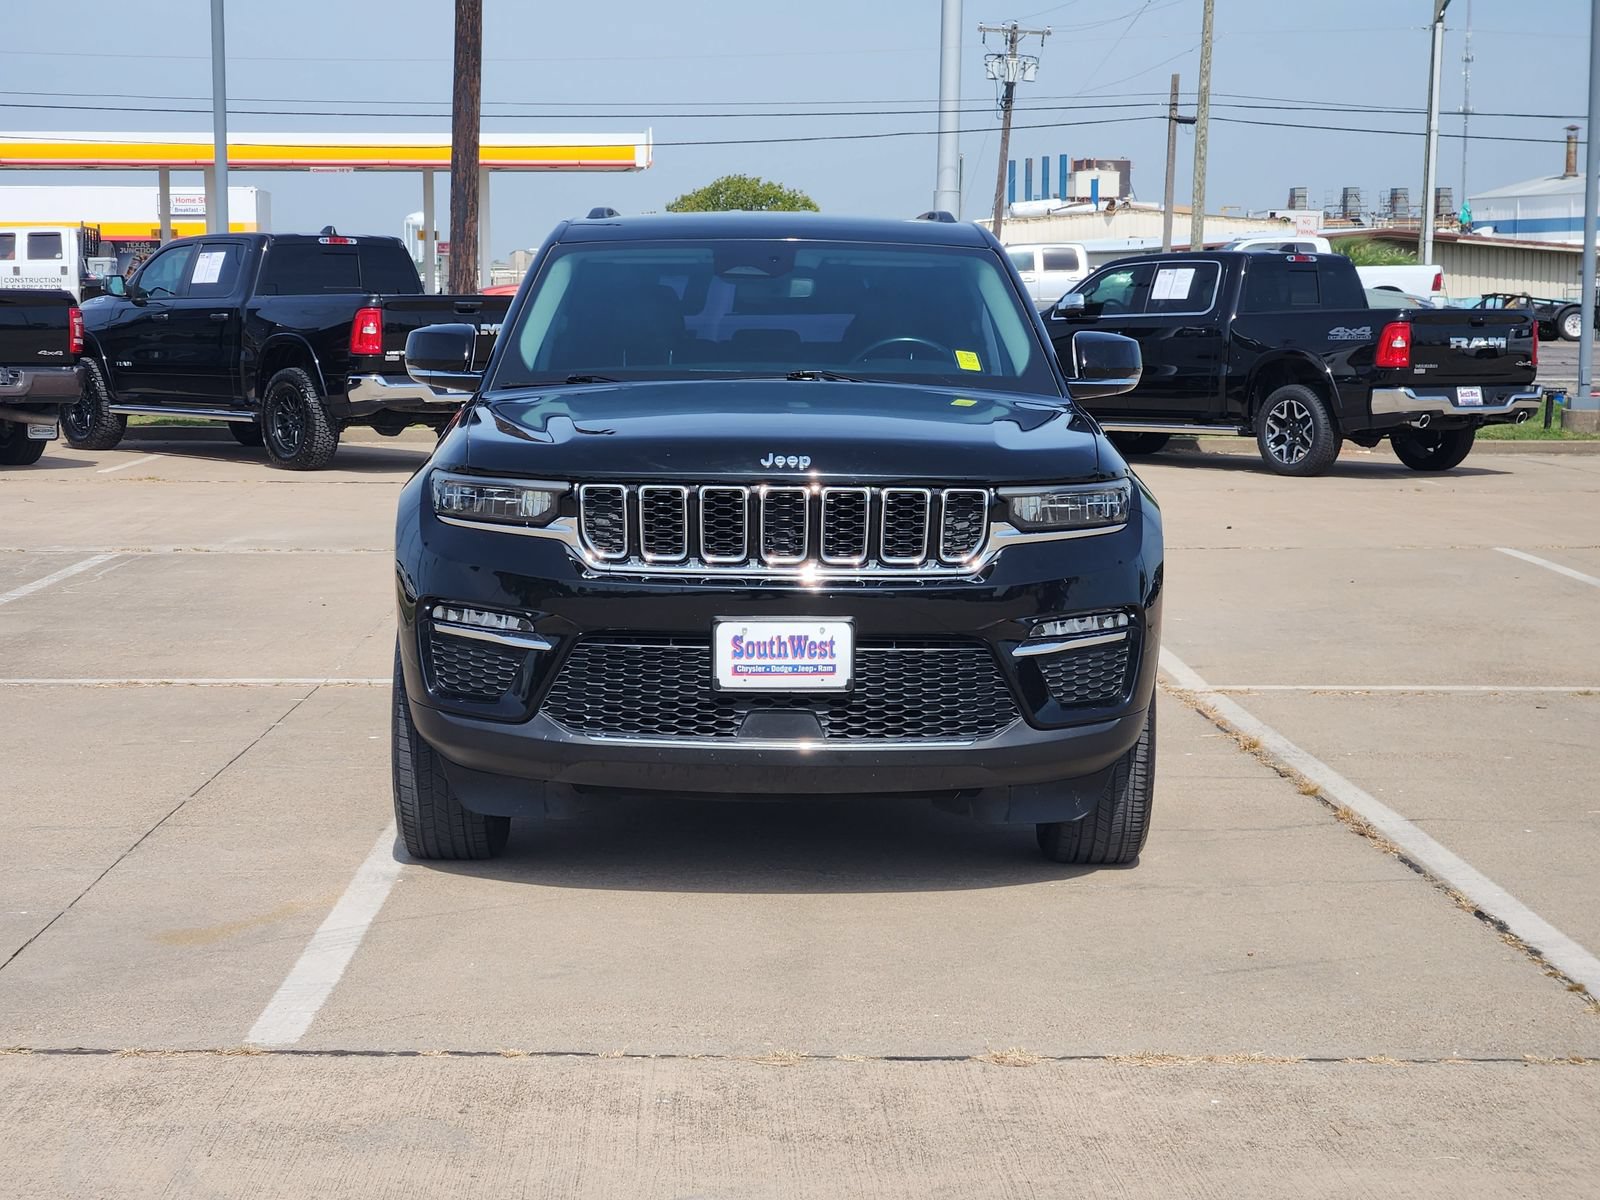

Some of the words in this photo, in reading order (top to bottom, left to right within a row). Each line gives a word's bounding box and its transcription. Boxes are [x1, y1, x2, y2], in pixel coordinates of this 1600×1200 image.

[1302, 218, 1312, 226] NO
[1328, 326, 1373, 336] 4x4
[1449, 337, 1506, 348] RAM
[760, 453, 812, 470] Jeep
[731, 634, 837, 660] SouthWest
[737, 664, 765, 674] Chrysler
[771, 664, 793, 674] Dodge
[797, 664, 814, 674] Jeep
[818, 664, 834, 673] Ram
